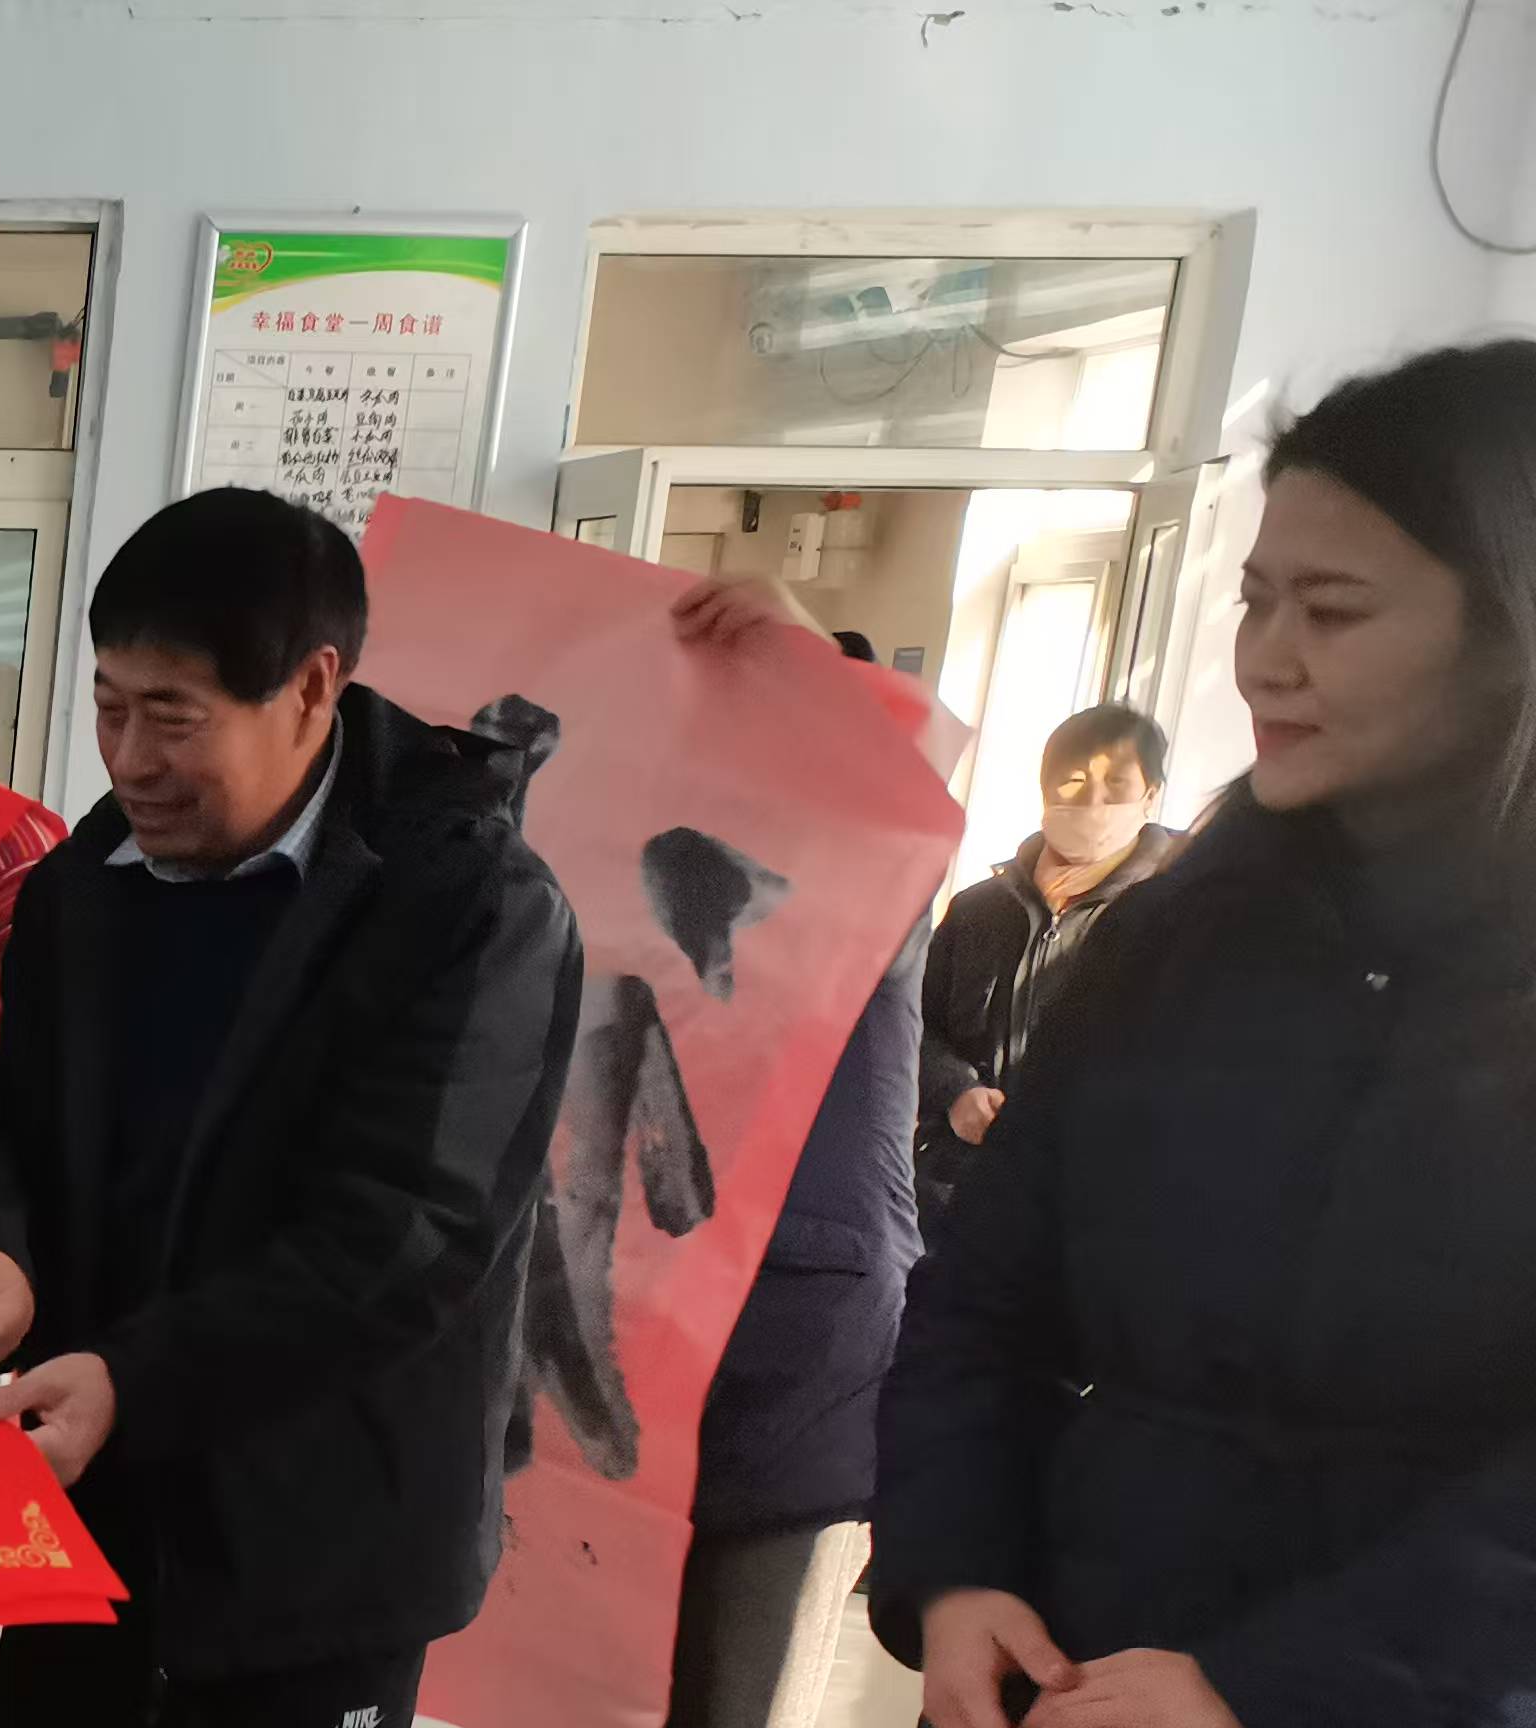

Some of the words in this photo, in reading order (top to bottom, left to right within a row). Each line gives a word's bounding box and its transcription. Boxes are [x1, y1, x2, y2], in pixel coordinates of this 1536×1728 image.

[252, 311, 445, 335] 幸福食堂一周食谱
